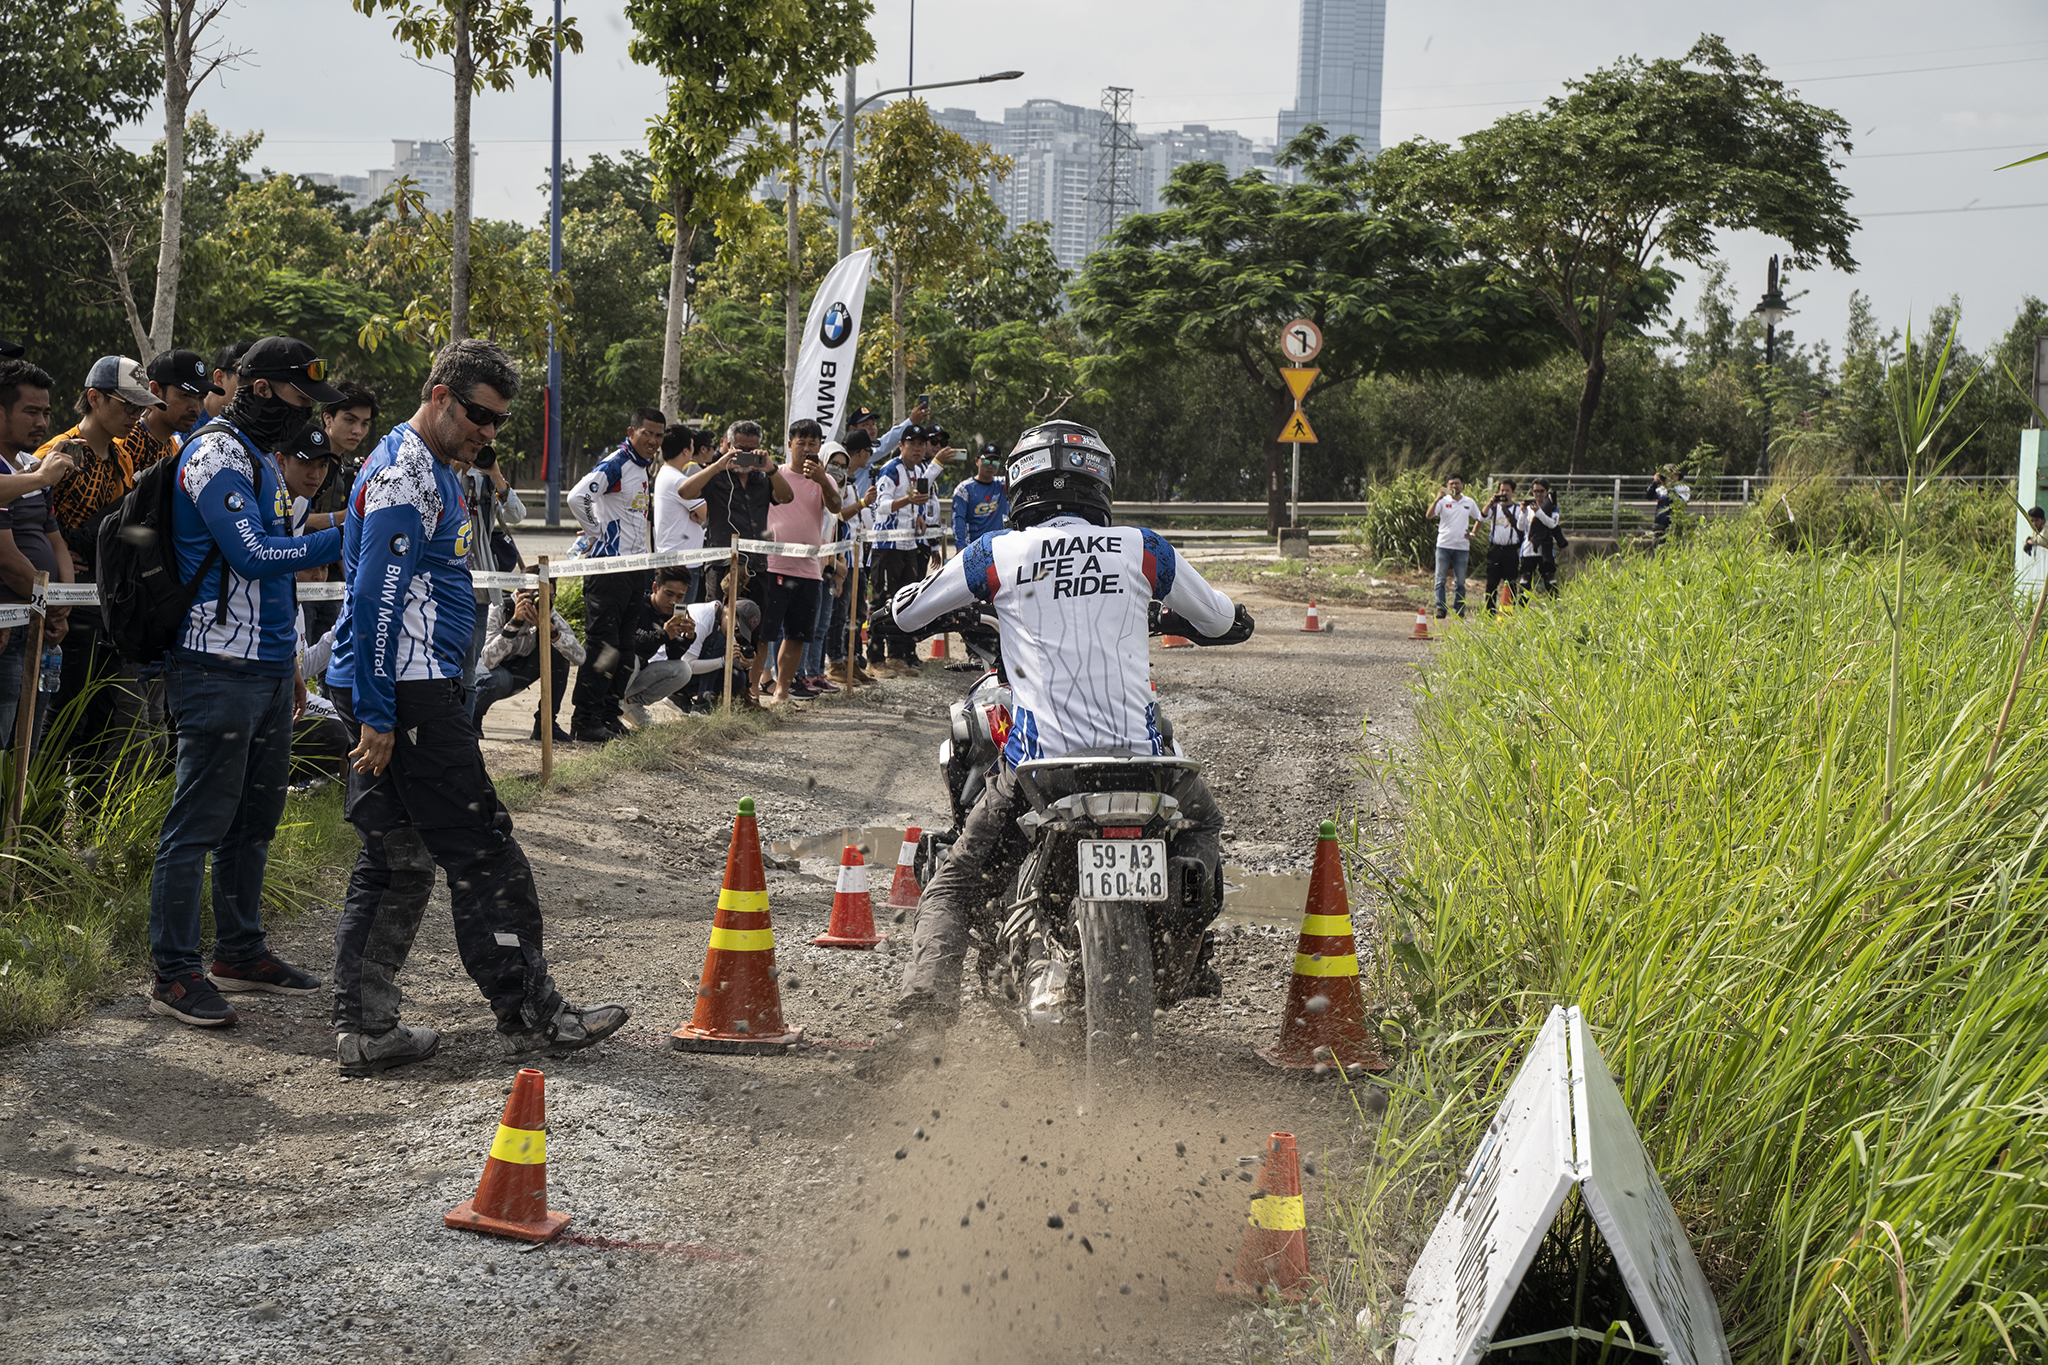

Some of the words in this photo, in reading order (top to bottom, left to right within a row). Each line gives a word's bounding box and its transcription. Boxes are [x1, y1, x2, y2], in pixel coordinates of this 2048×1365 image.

[815, 360, 837, 428] BMW
[1085, 452, 1101, 463] BMW
[235, 518, 261, 554] BMW
[1040, 536, 1122, 559] MAKE
[381, 564, 402, 606] BMW
[1016, 557, 1075, 585] LIFE
[1080, 555, 1102, 575] A
[1053, 574, 1124, 600] RIDE.
[374, 607, 394, 678] Motorrad
[1092, 844, 1154, 869] 59-A3
